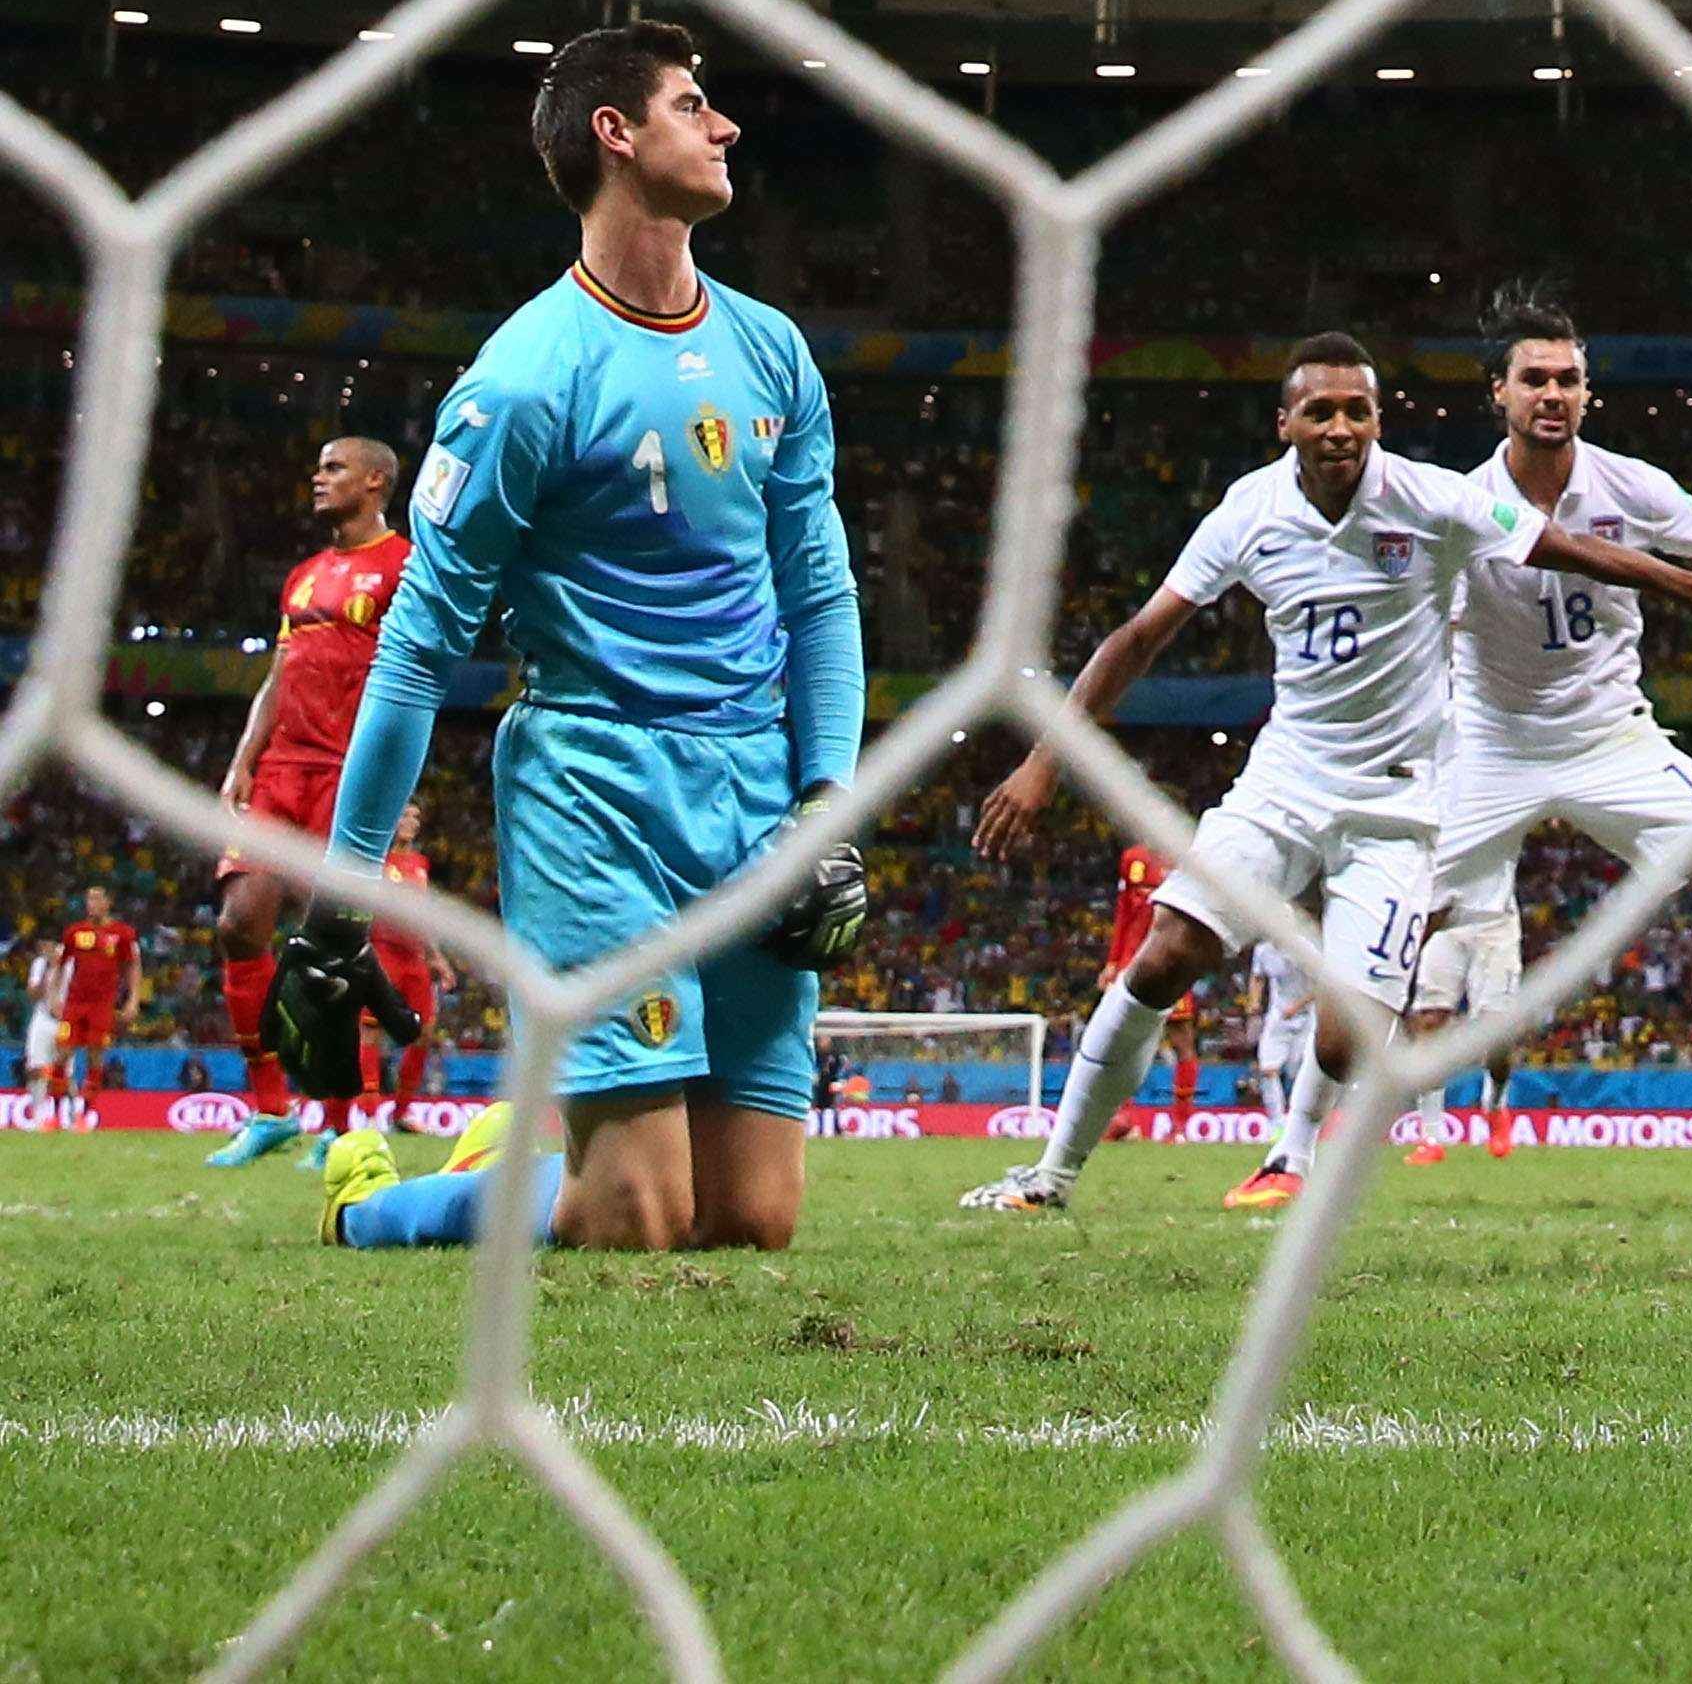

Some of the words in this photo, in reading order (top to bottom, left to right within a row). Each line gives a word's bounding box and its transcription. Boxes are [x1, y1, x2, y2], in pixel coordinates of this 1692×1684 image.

[632, 428, 669, 515] 1
[1298, 600, 1364, 663] 16
[1538, 591, 1595, 651] 18
